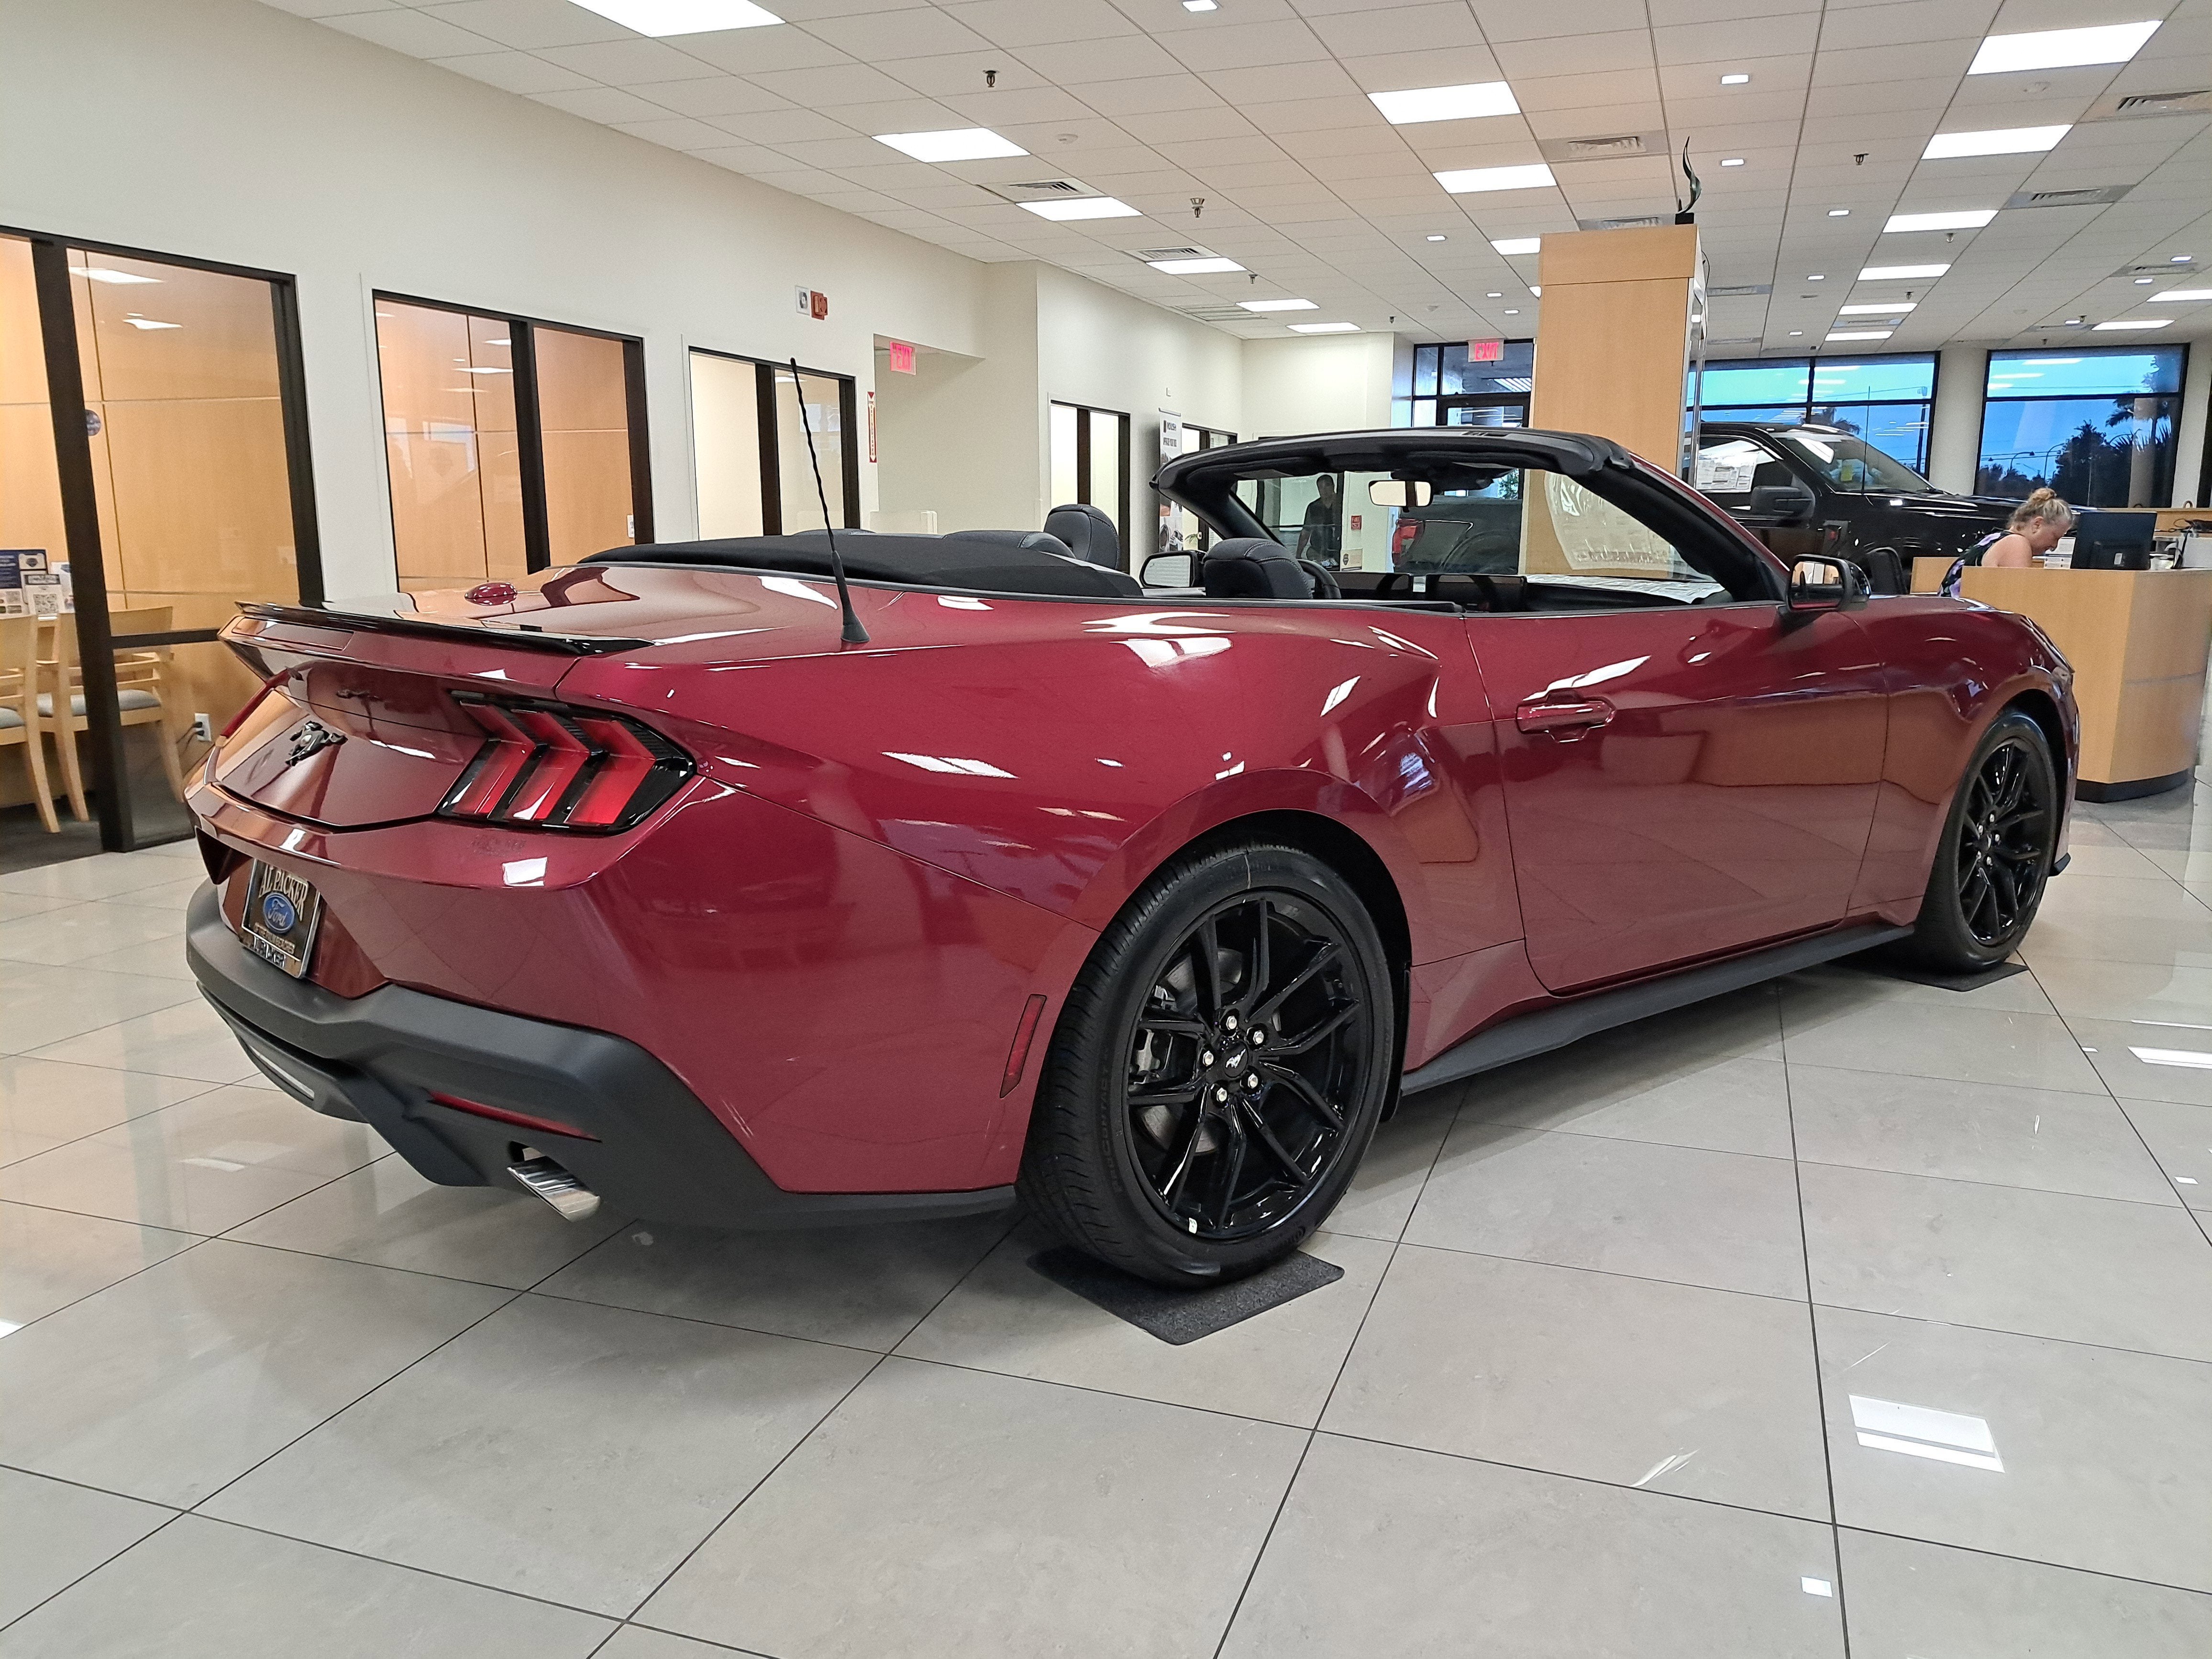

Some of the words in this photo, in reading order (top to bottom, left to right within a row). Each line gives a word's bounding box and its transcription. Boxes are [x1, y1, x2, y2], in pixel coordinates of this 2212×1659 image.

[896, 344, 912, 371] EXIT
[1475, 343, 1499, 360] EXIT
[258, 863, 274, 898] AL
[274, 870, 308, 921] PACKER
[267, 898, 288, 927] Ford
